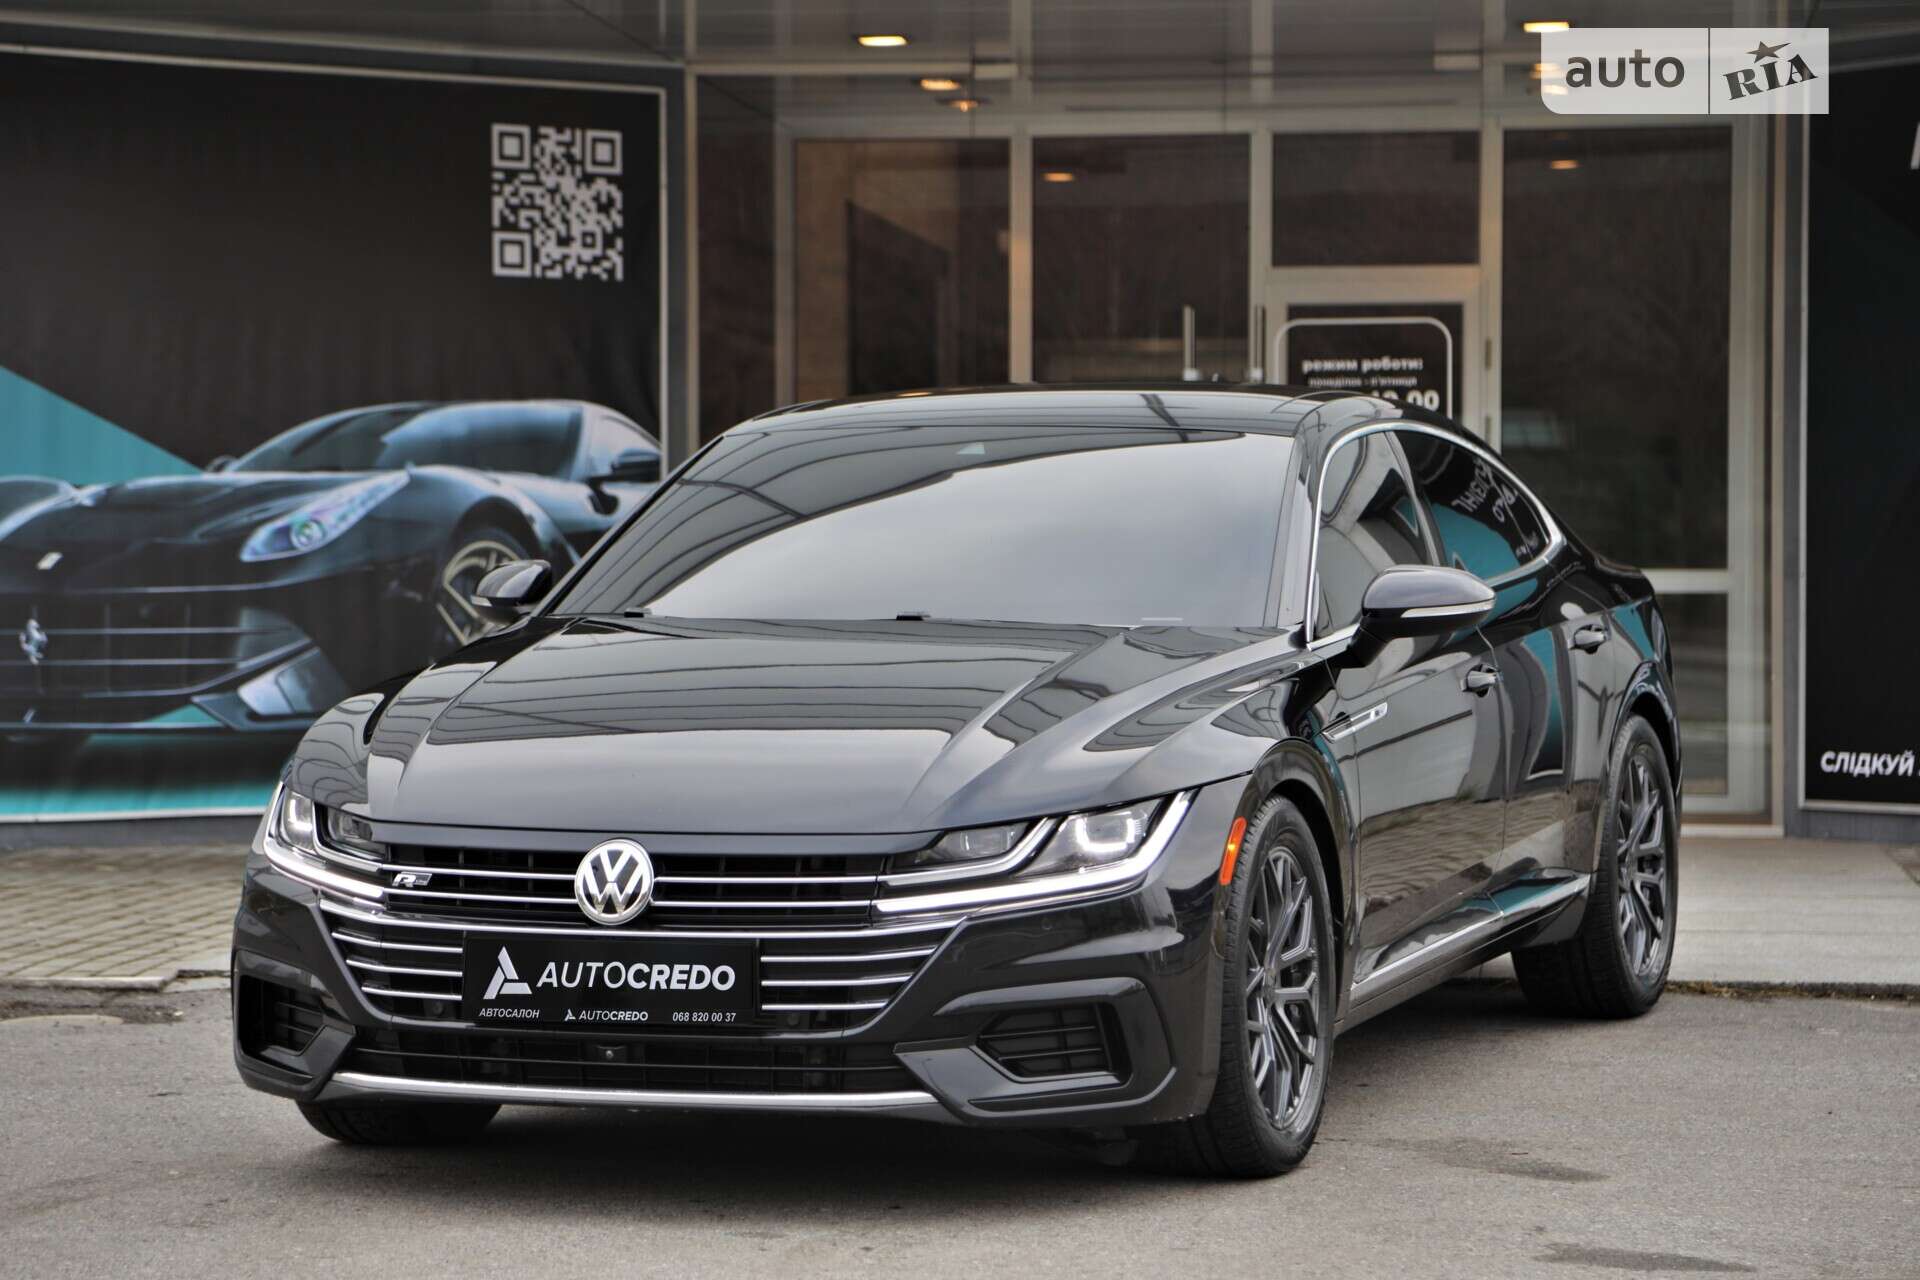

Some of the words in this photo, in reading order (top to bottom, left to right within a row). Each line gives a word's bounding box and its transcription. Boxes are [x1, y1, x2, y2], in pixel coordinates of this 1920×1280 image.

[1820, 750, 1915, 778] СЛІДКУЙ
[535, 960, 736, 992] AUTOCREDO
[478, 1007, 541, 1020] АВТОСАЛОН
[578, 1009, 649, 1022] AUTOCREDO
[672, 1011, 690, 1022] 068
[691, 1011, 709, 1022] 820
[711, 1012, 723, 1022] 00
[725, 1012, 737, 1023] 37
